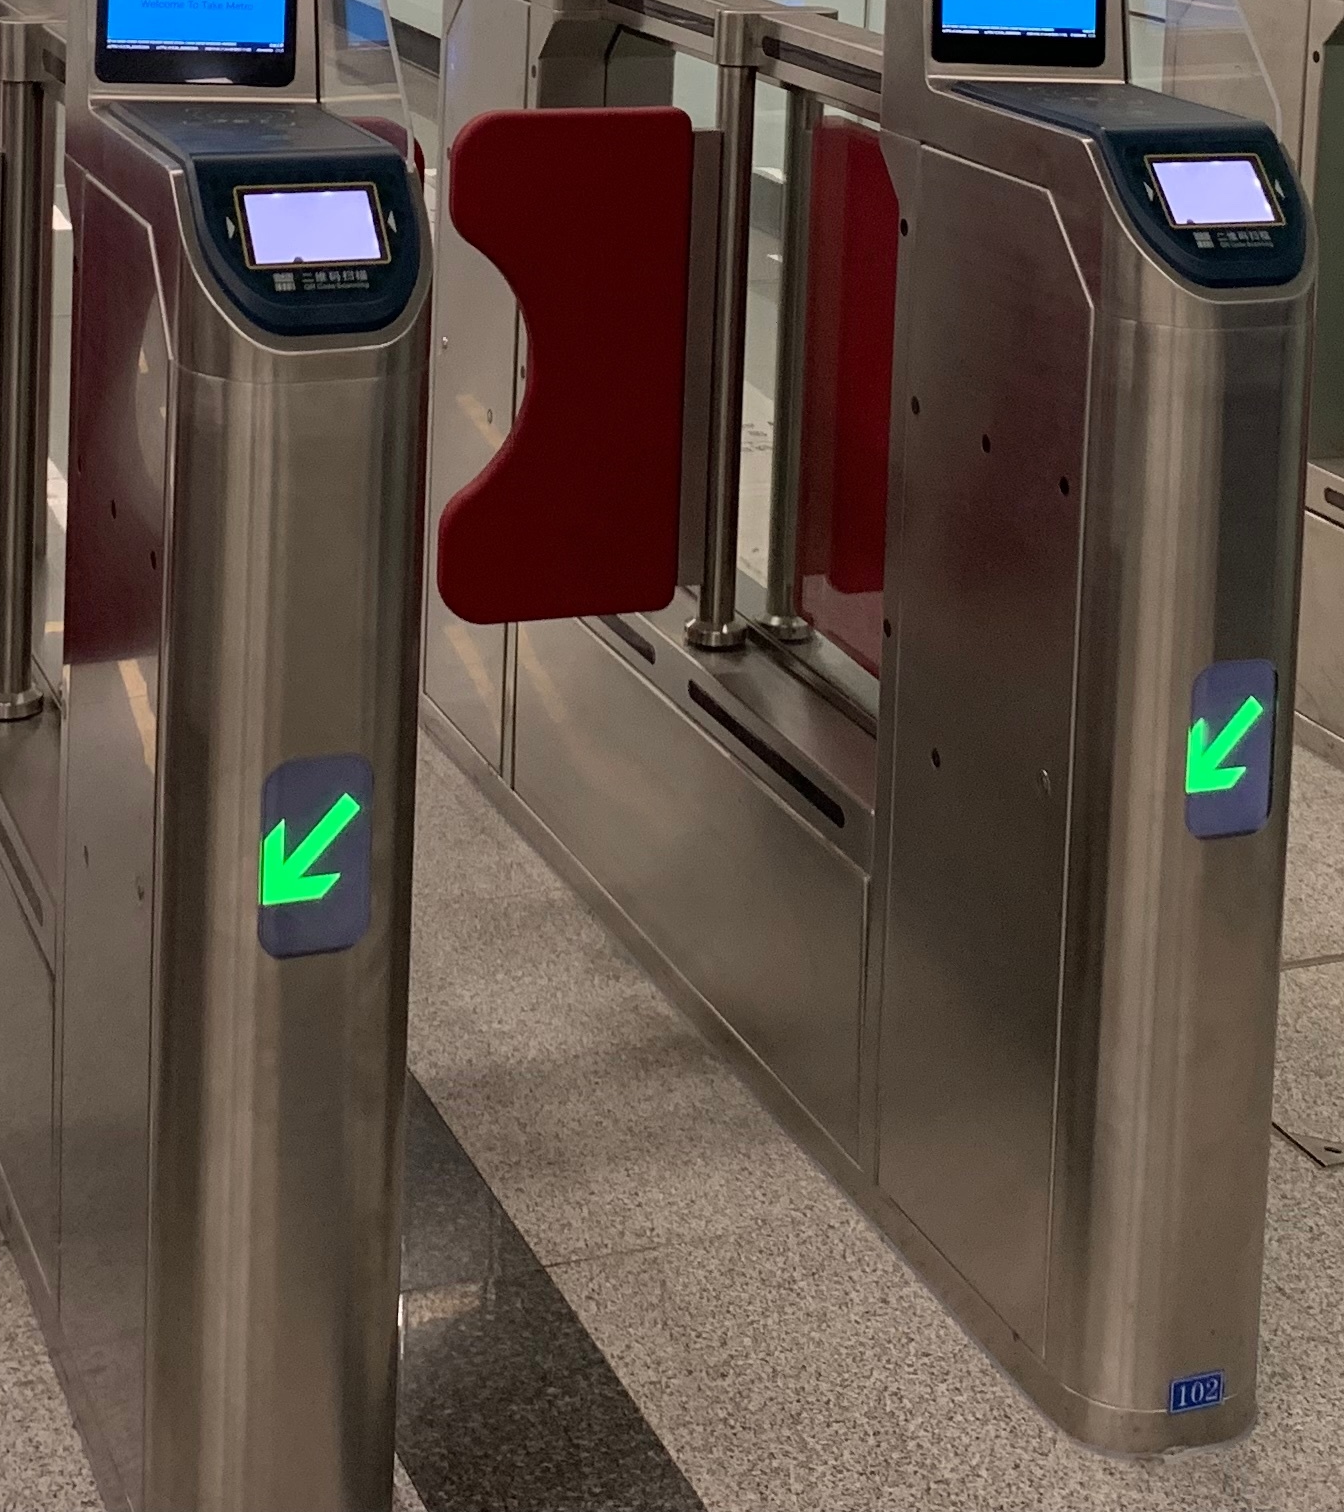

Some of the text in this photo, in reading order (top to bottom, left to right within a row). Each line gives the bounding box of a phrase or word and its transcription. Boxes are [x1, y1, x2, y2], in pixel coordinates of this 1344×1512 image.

[142, 0, 185, 9] Welcome
[188, 0, 199, 9] To
[1177, 1378, 1219, 1407] 102
